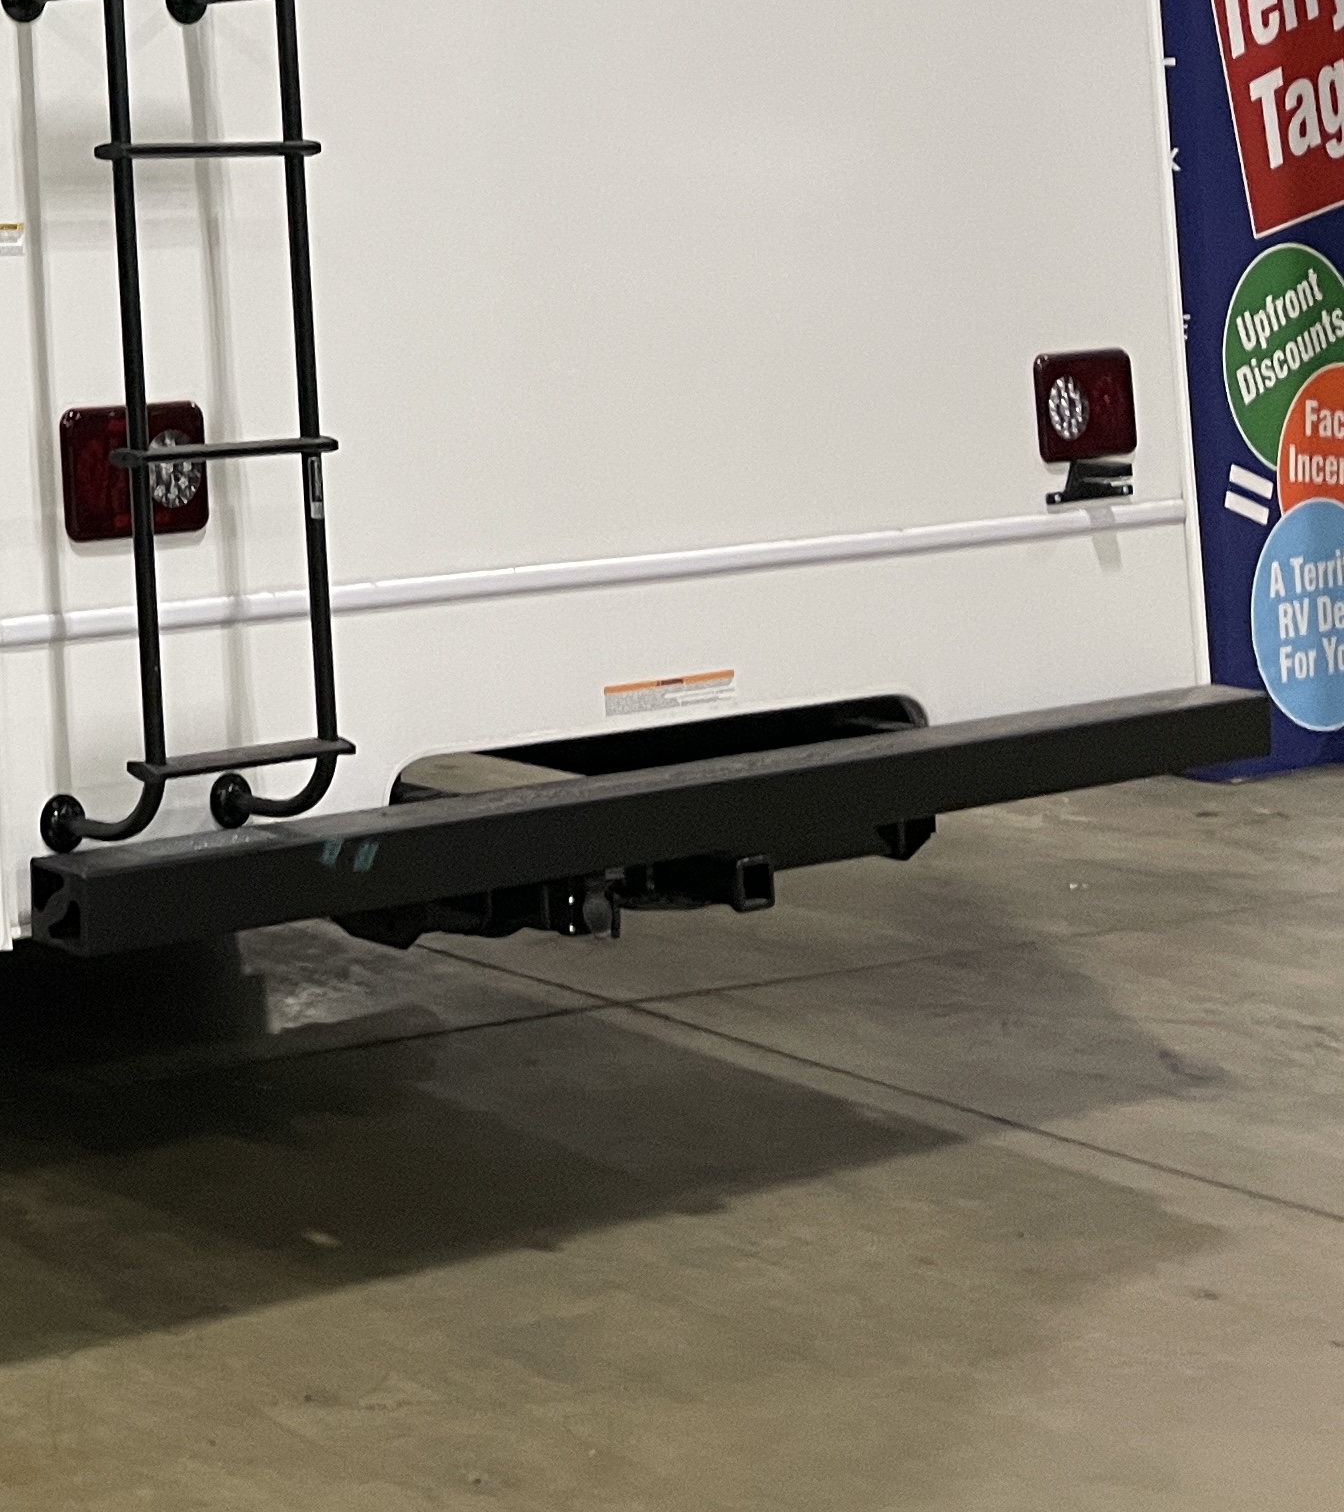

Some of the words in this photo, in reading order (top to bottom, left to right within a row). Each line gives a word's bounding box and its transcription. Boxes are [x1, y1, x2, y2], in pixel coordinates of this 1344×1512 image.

[1236, 268, 1323, 352] Upfront
[1236, 307, 1344, 407] Discounts
[1269, 560, 1285, 599] A
[1278, 596, 1310, 640] RV
[1279, 645, 1316, 684] For
